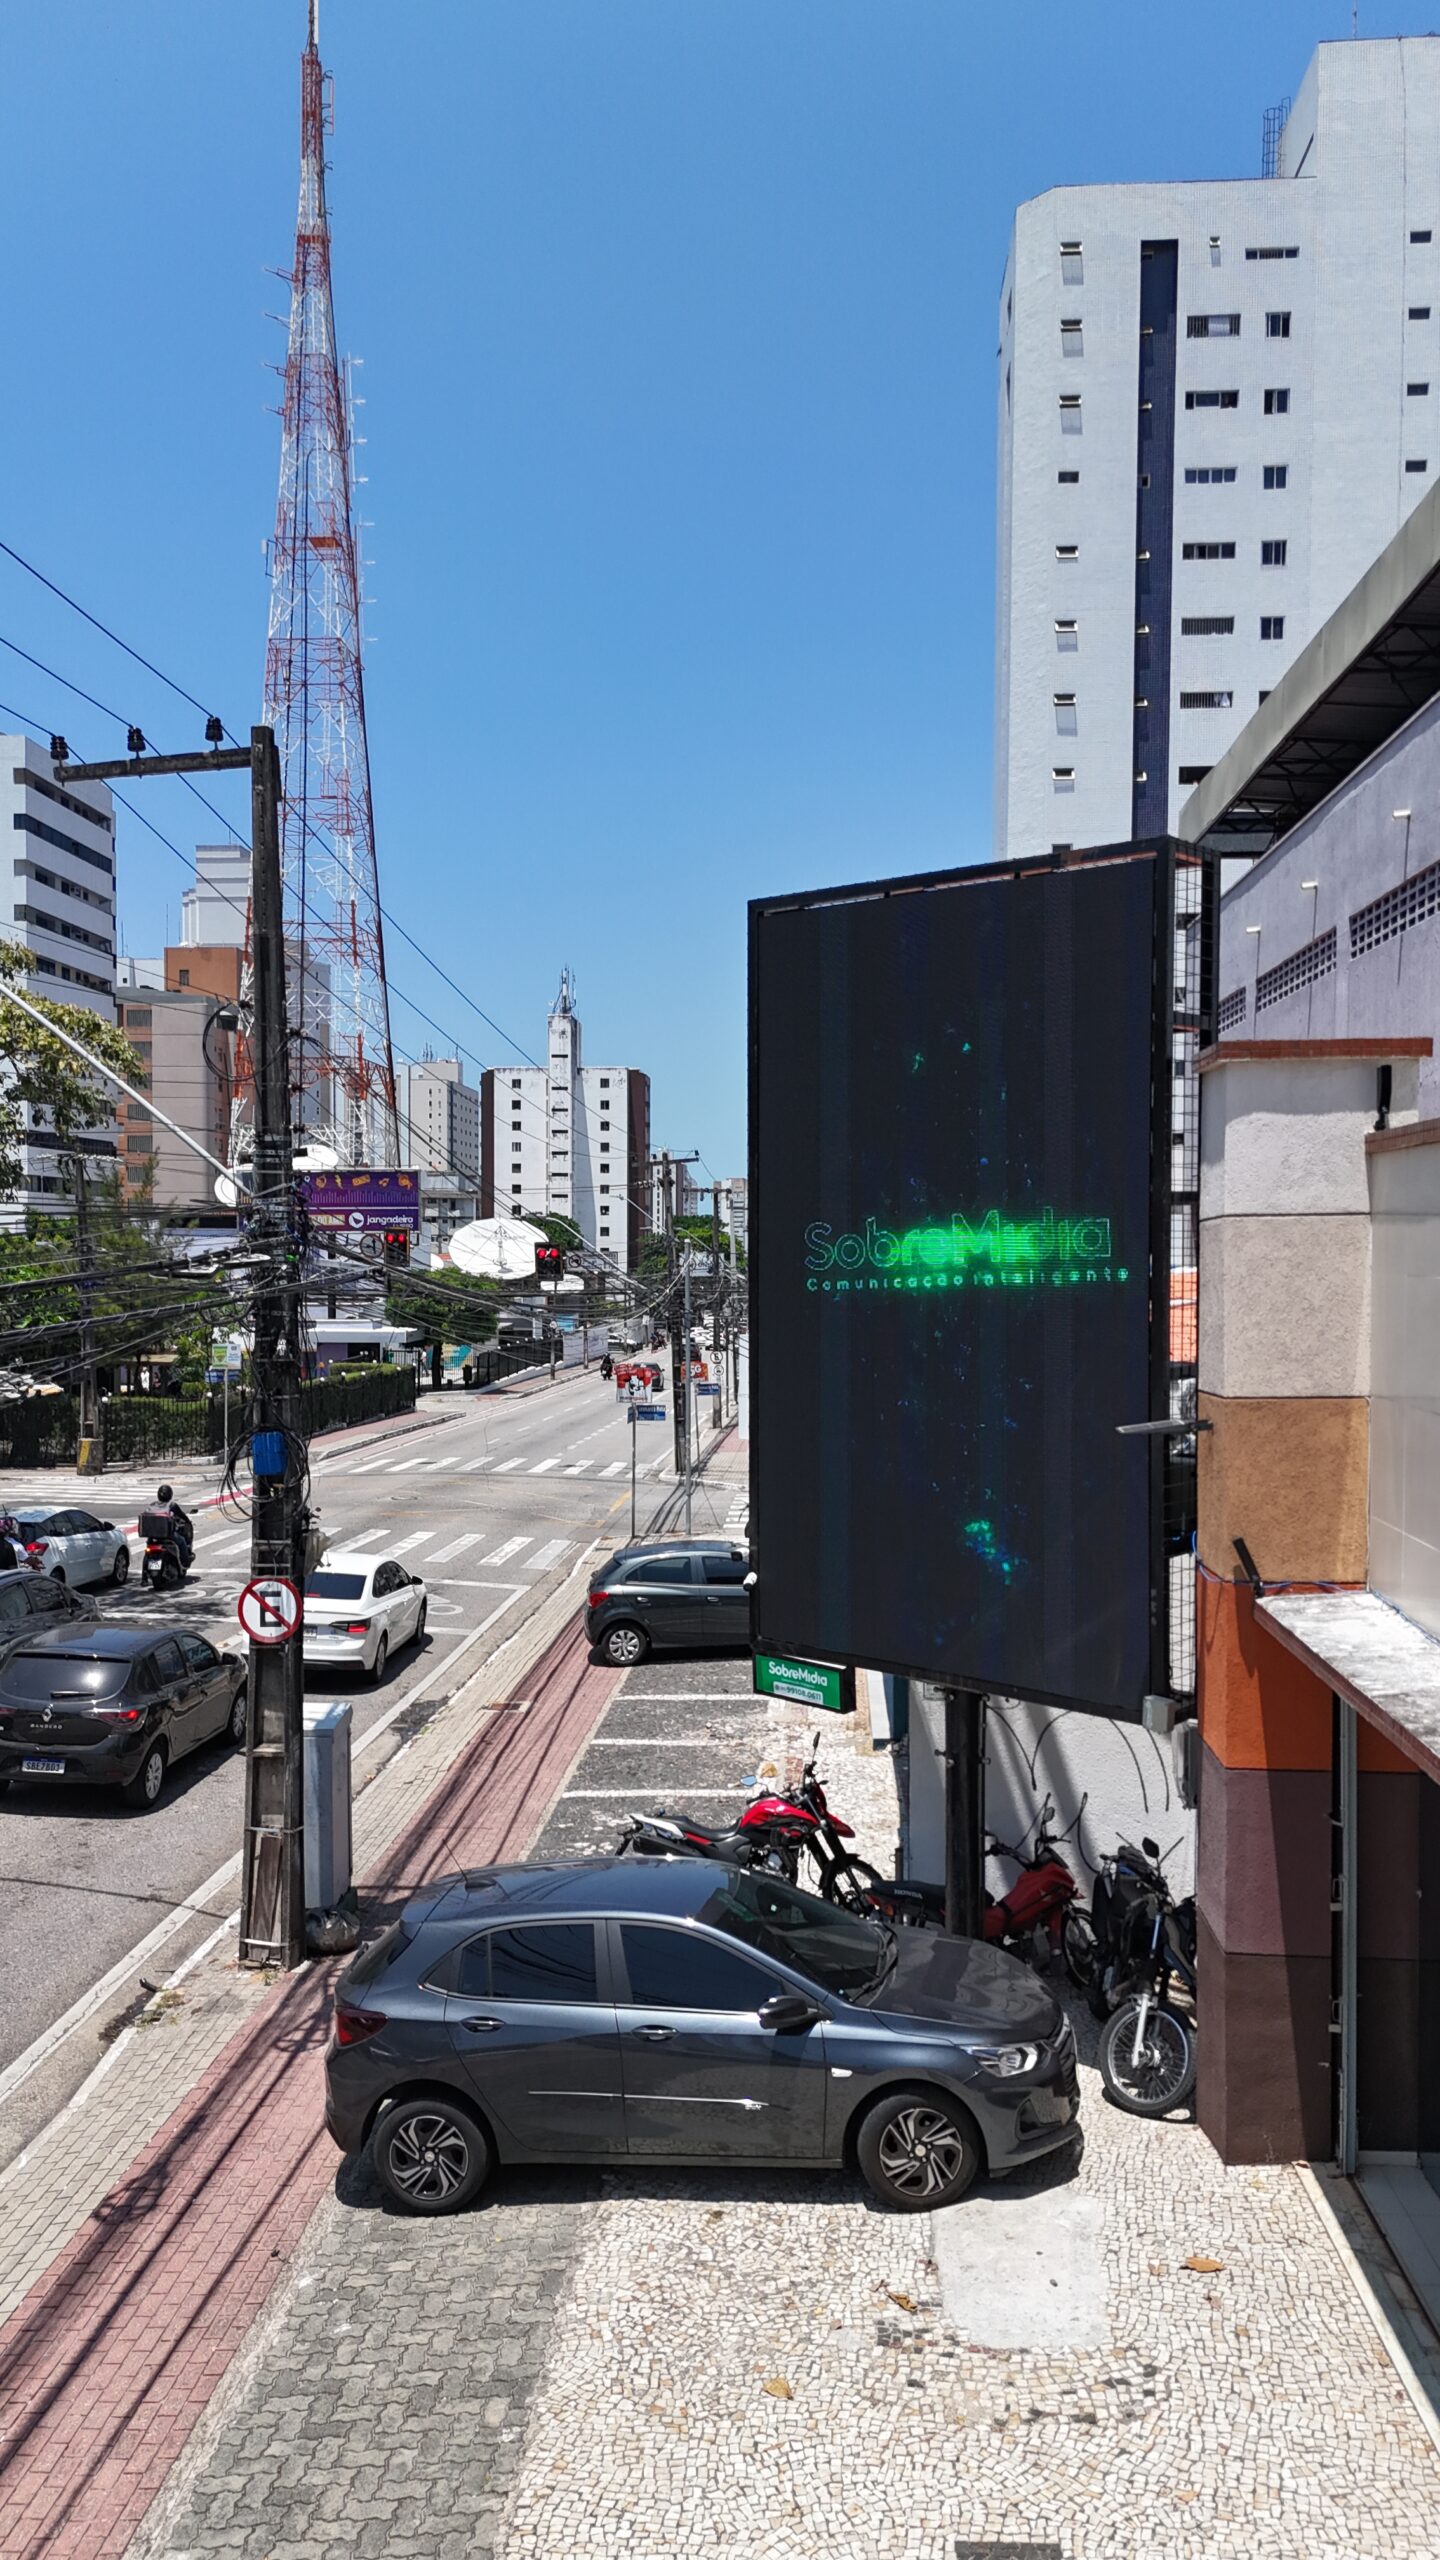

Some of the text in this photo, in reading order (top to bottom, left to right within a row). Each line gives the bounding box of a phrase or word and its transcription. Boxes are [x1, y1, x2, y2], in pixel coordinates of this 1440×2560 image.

[366, 1214, 414, 1227] jangadeiro
[259, 1590, 282, 1628] E
[768, 1661, 828, 1686] SobreMidia
[894, 1888, 923, 1899] HONDA
